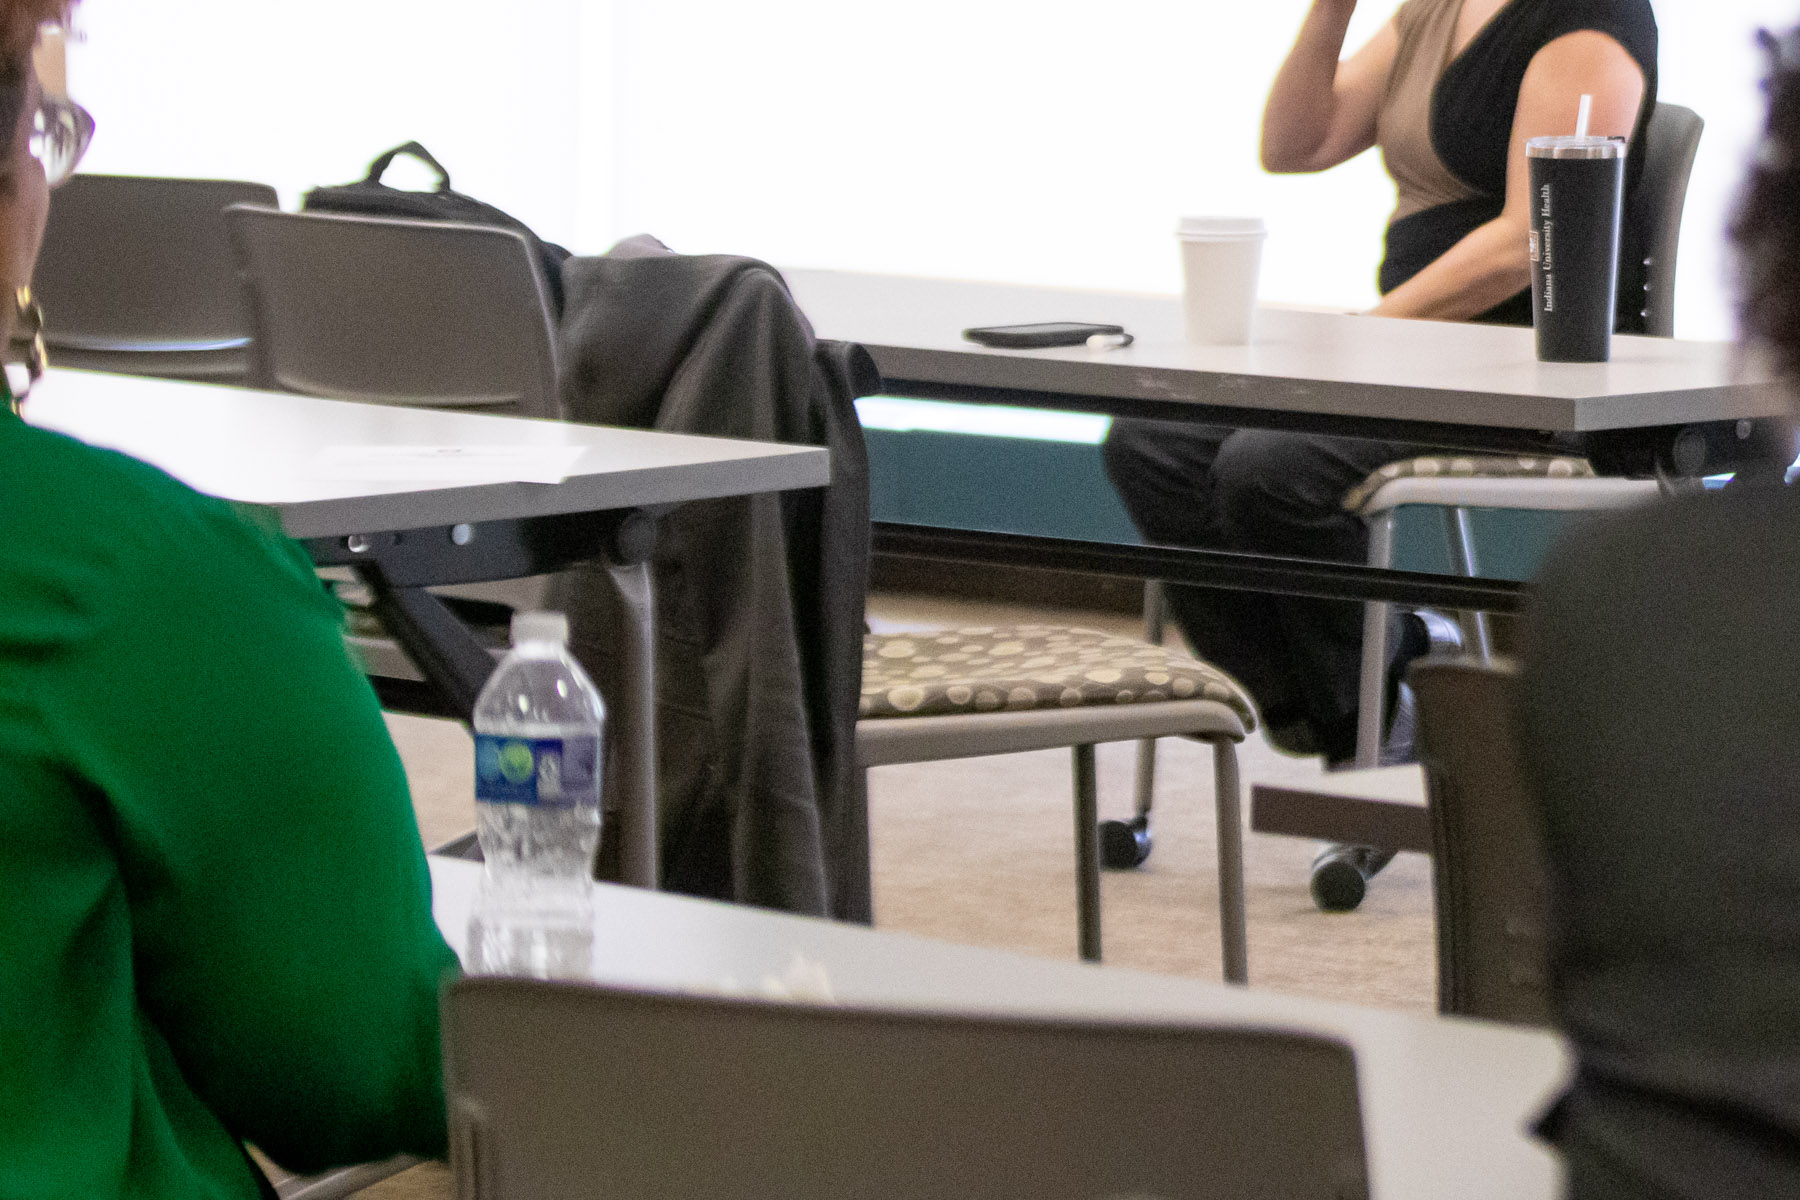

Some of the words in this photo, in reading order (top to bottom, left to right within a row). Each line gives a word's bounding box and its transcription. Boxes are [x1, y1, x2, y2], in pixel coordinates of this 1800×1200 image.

[1540, 184, 1552, 218] Health
[1541, 220, 1554, 271] University
[1543, 274, 1553, 313] Indiana
